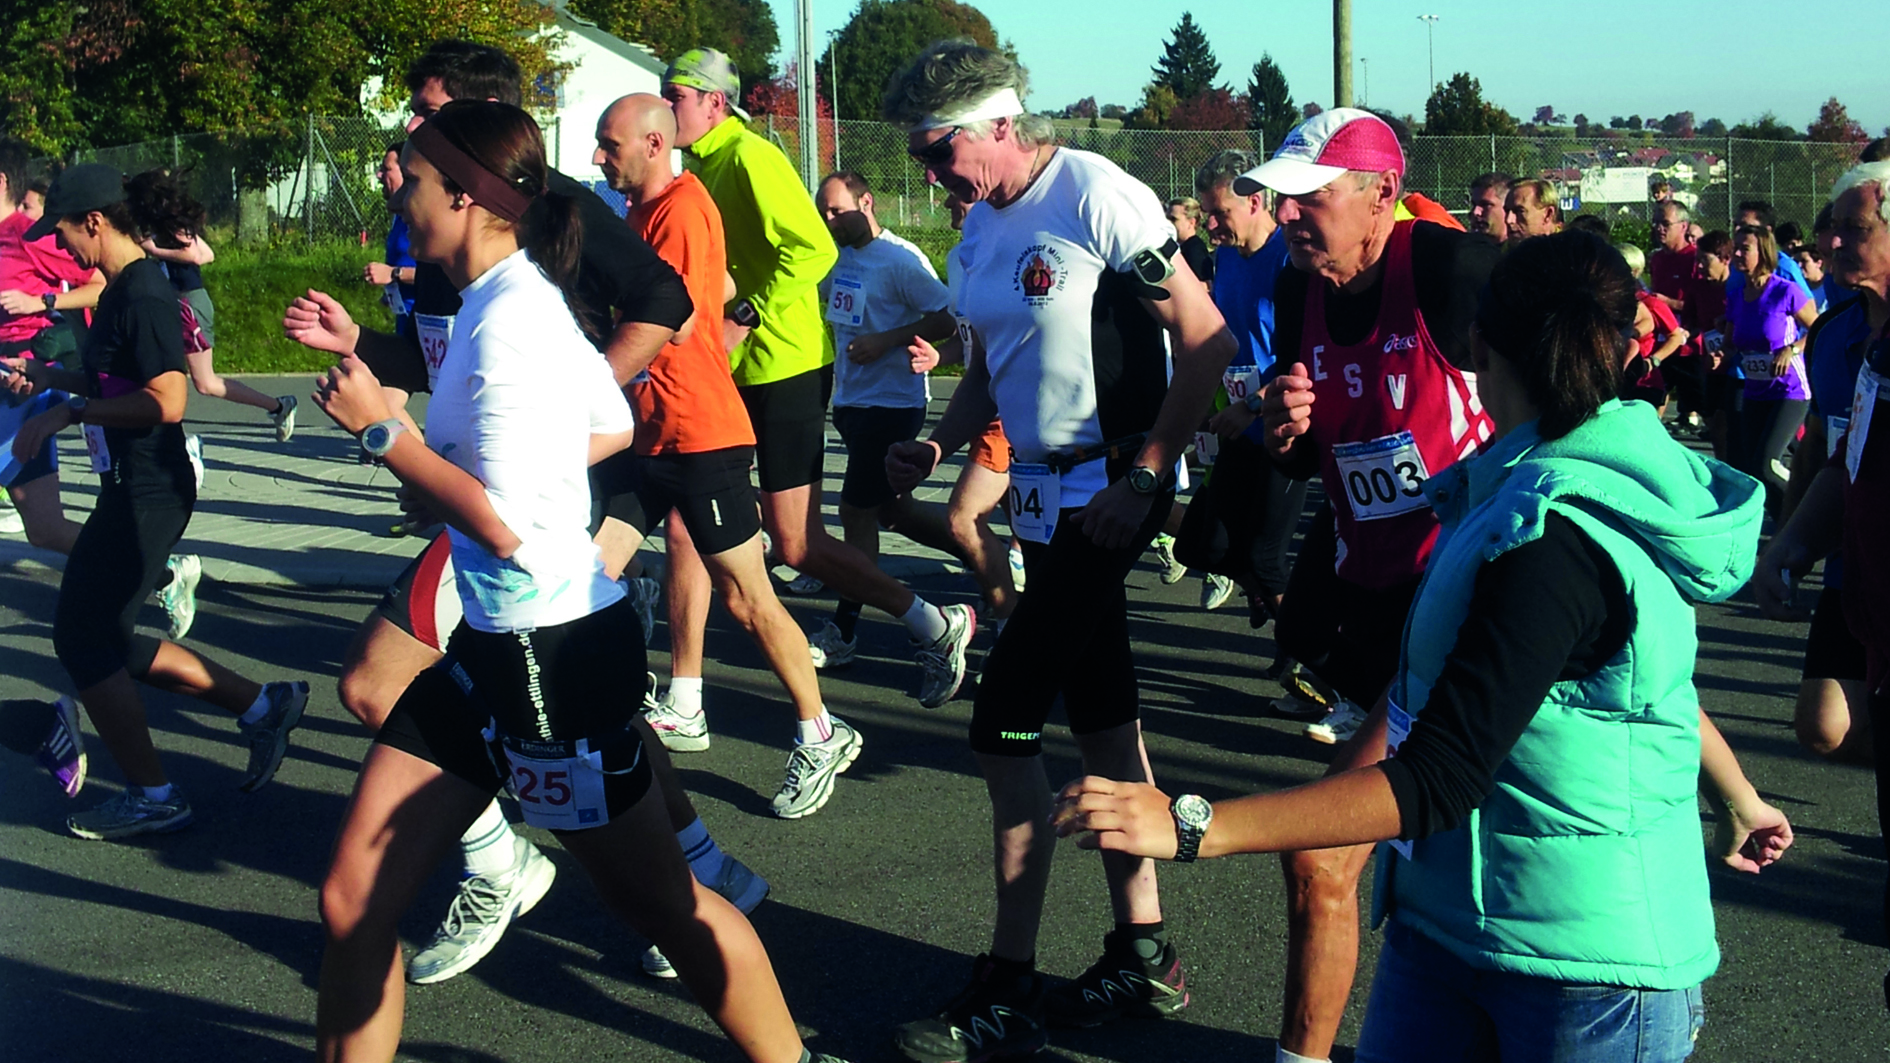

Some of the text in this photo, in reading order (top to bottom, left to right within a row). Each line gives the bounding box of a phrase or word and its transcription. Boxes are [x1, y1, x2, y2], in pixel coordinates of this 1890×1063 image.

[1012, 486, 1043, 519] 04
[1348, 461, 1424, 506] 003
[508, 761, 572, 806] 25
